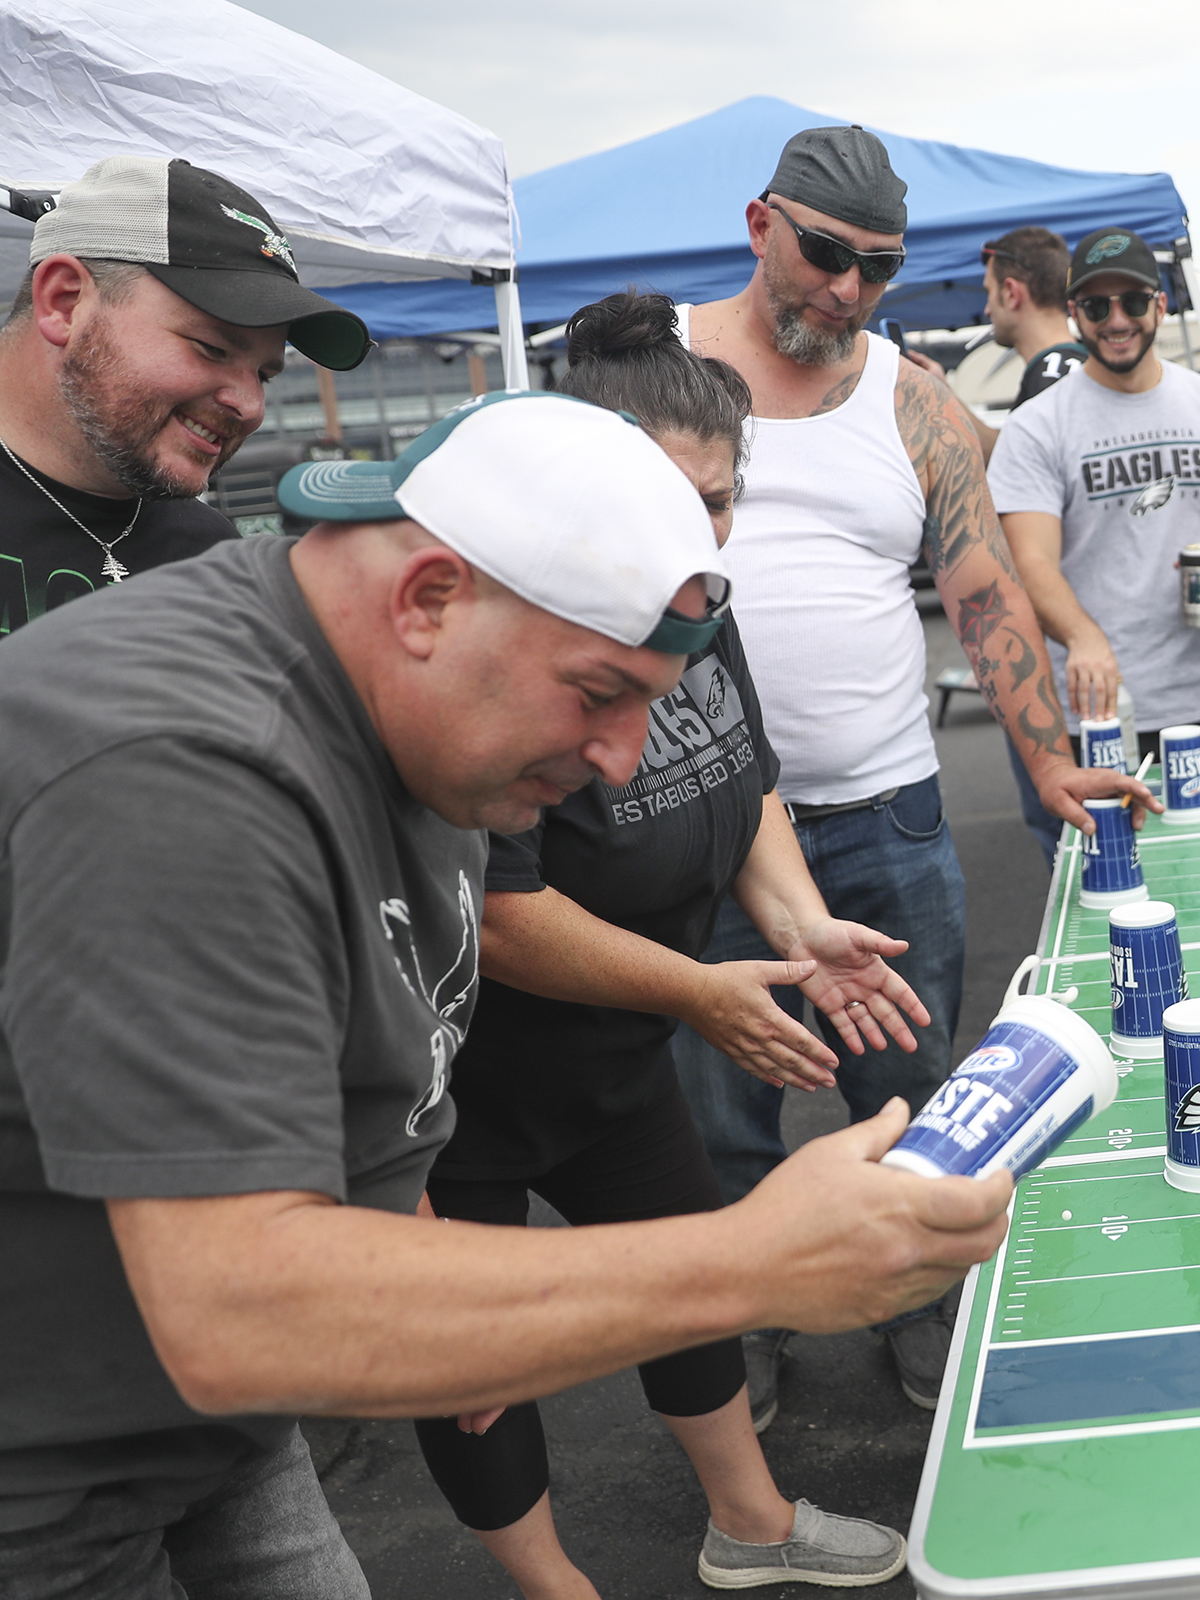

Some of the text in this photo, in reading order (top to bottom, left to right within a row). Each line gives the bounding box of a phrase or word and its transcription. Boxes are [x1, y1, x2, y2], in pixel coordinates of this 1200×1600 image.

[1093, 428, 1194, 450] PHILADELPHIA
[727, 742, 754, 775] 193
[947, 1122, 982, 1152] TURF
[1108, 1128, 1132, 1145] 20
[1101, 1215, 1129, 1235] 10
